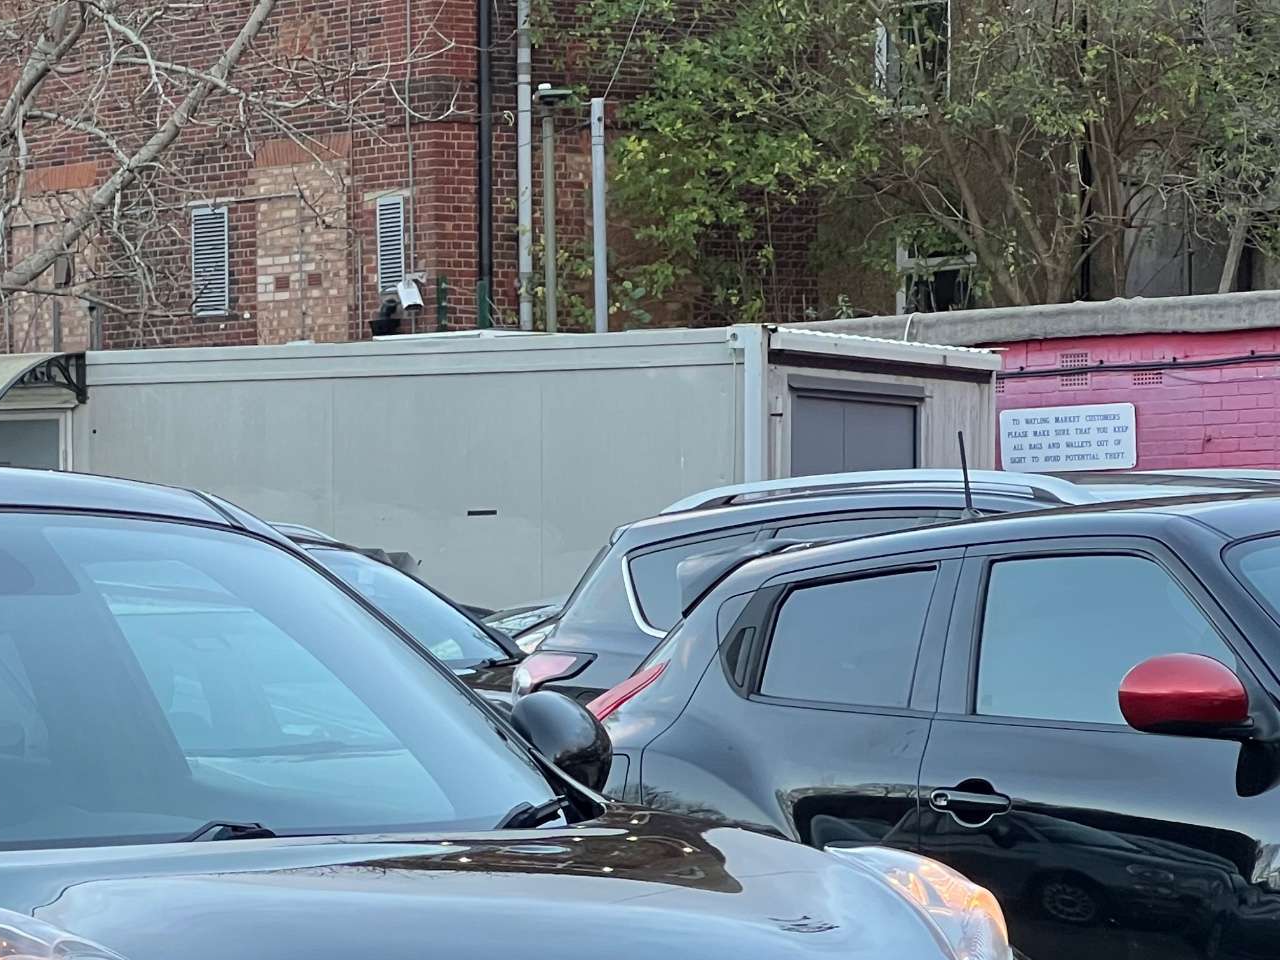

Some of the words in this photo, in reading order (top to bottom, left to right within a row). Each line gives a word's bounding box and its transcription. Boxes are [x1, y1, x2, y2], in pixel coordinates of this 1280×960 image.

[1054, 415, 1081, 424] MARKET
[1085, 413, 1120, 422] CUSTOMERS
[1007, 430, 1029, 438] PLEASE
[1033, 429, 1050, 437] MAKE
[1054, 428, 1070, 436] SURE
[1075, 427, 1091, 435] THAT
[1096, 426, 1108, 434] YOU
[1113, 425, 1129, 433] KEEP
[1013, 443, 1023, 451] ALL
[1028, 442, 1043, 450] BAGS
[1065, 440, 1092, 448] WALLETS
[1096, 439, 1108, 447] OUT
[1010, 456, 1026, 464] SIGHT
[1044, 455, 1061, 463] AVOID
[1065, 453, 1099, 462] POTENTIAL
[1105, 452, 1125, 460] THEFT
